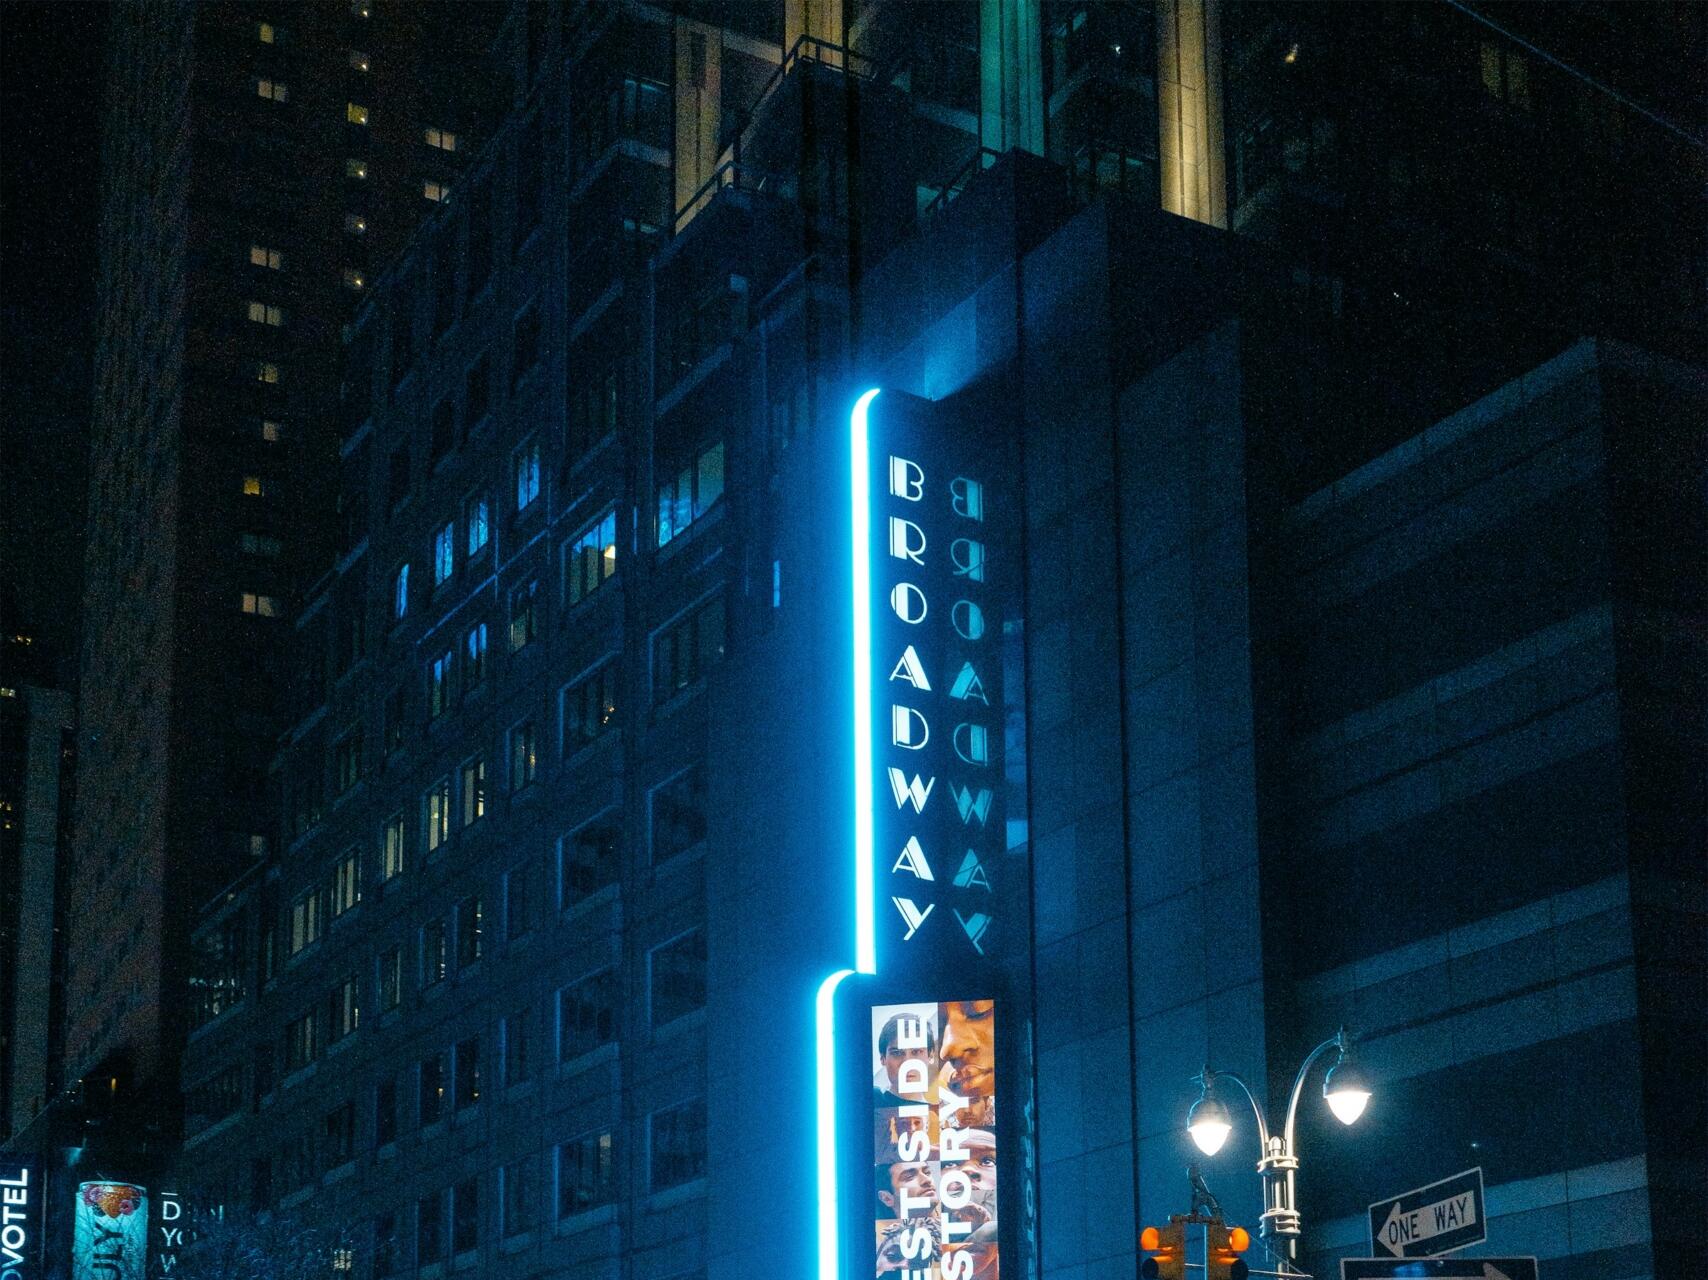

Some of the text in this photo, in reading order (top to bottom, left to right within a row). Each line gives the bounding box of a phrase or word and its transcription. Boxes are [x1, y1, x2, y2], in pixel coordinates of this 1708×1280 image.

[888, 455, 935, 942] BROADWAY
[897, 1018, 932, 1164] SIDE
[1388, 1197, 1468, 1246] ONE WAY
